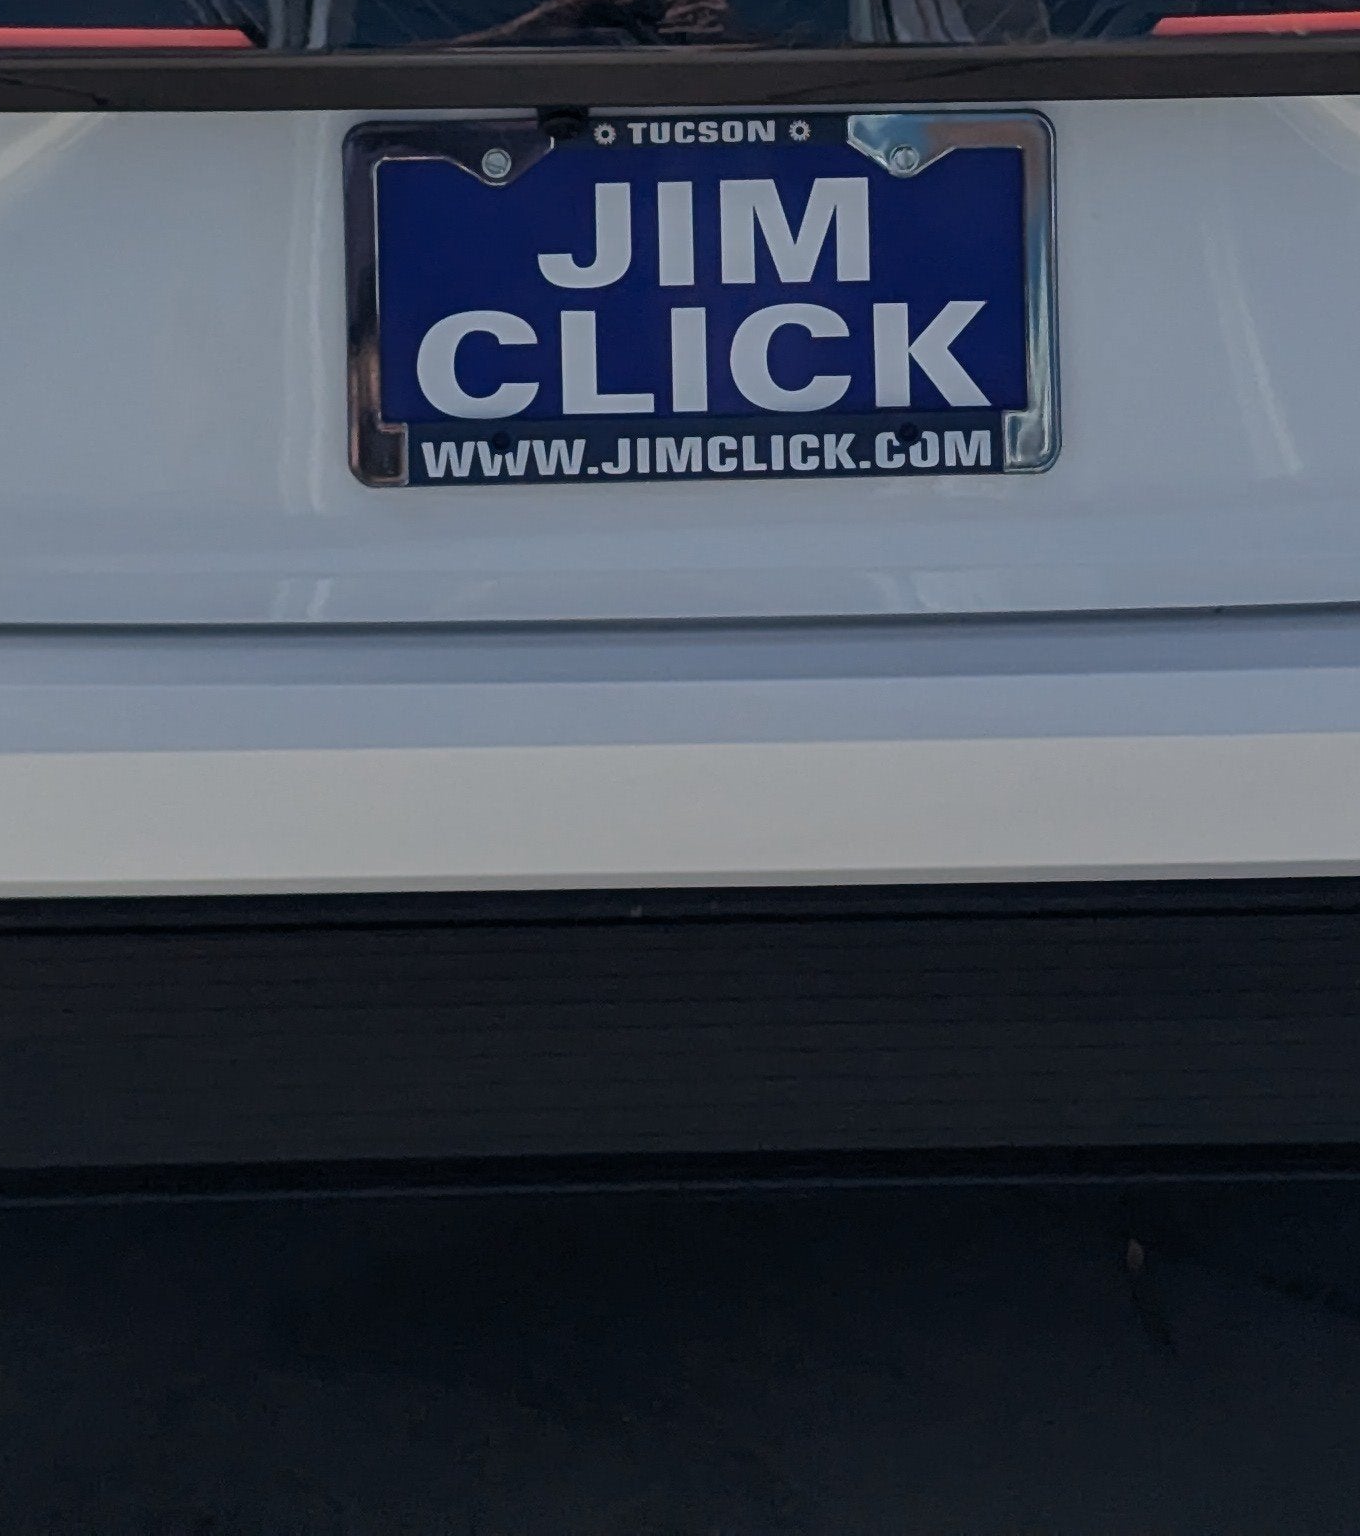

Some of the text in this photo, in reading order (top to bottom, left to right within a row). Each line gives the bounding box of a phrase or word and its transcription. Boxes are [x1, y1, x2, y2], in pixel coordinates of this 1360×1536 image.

[627, 120, 776, 145] TUCSON
[537, 176, 871, 289] JIM
[416, 300, 992, 419] CLICK
[421, 430, 992, 478] WWW.JIMCLICK.COM
